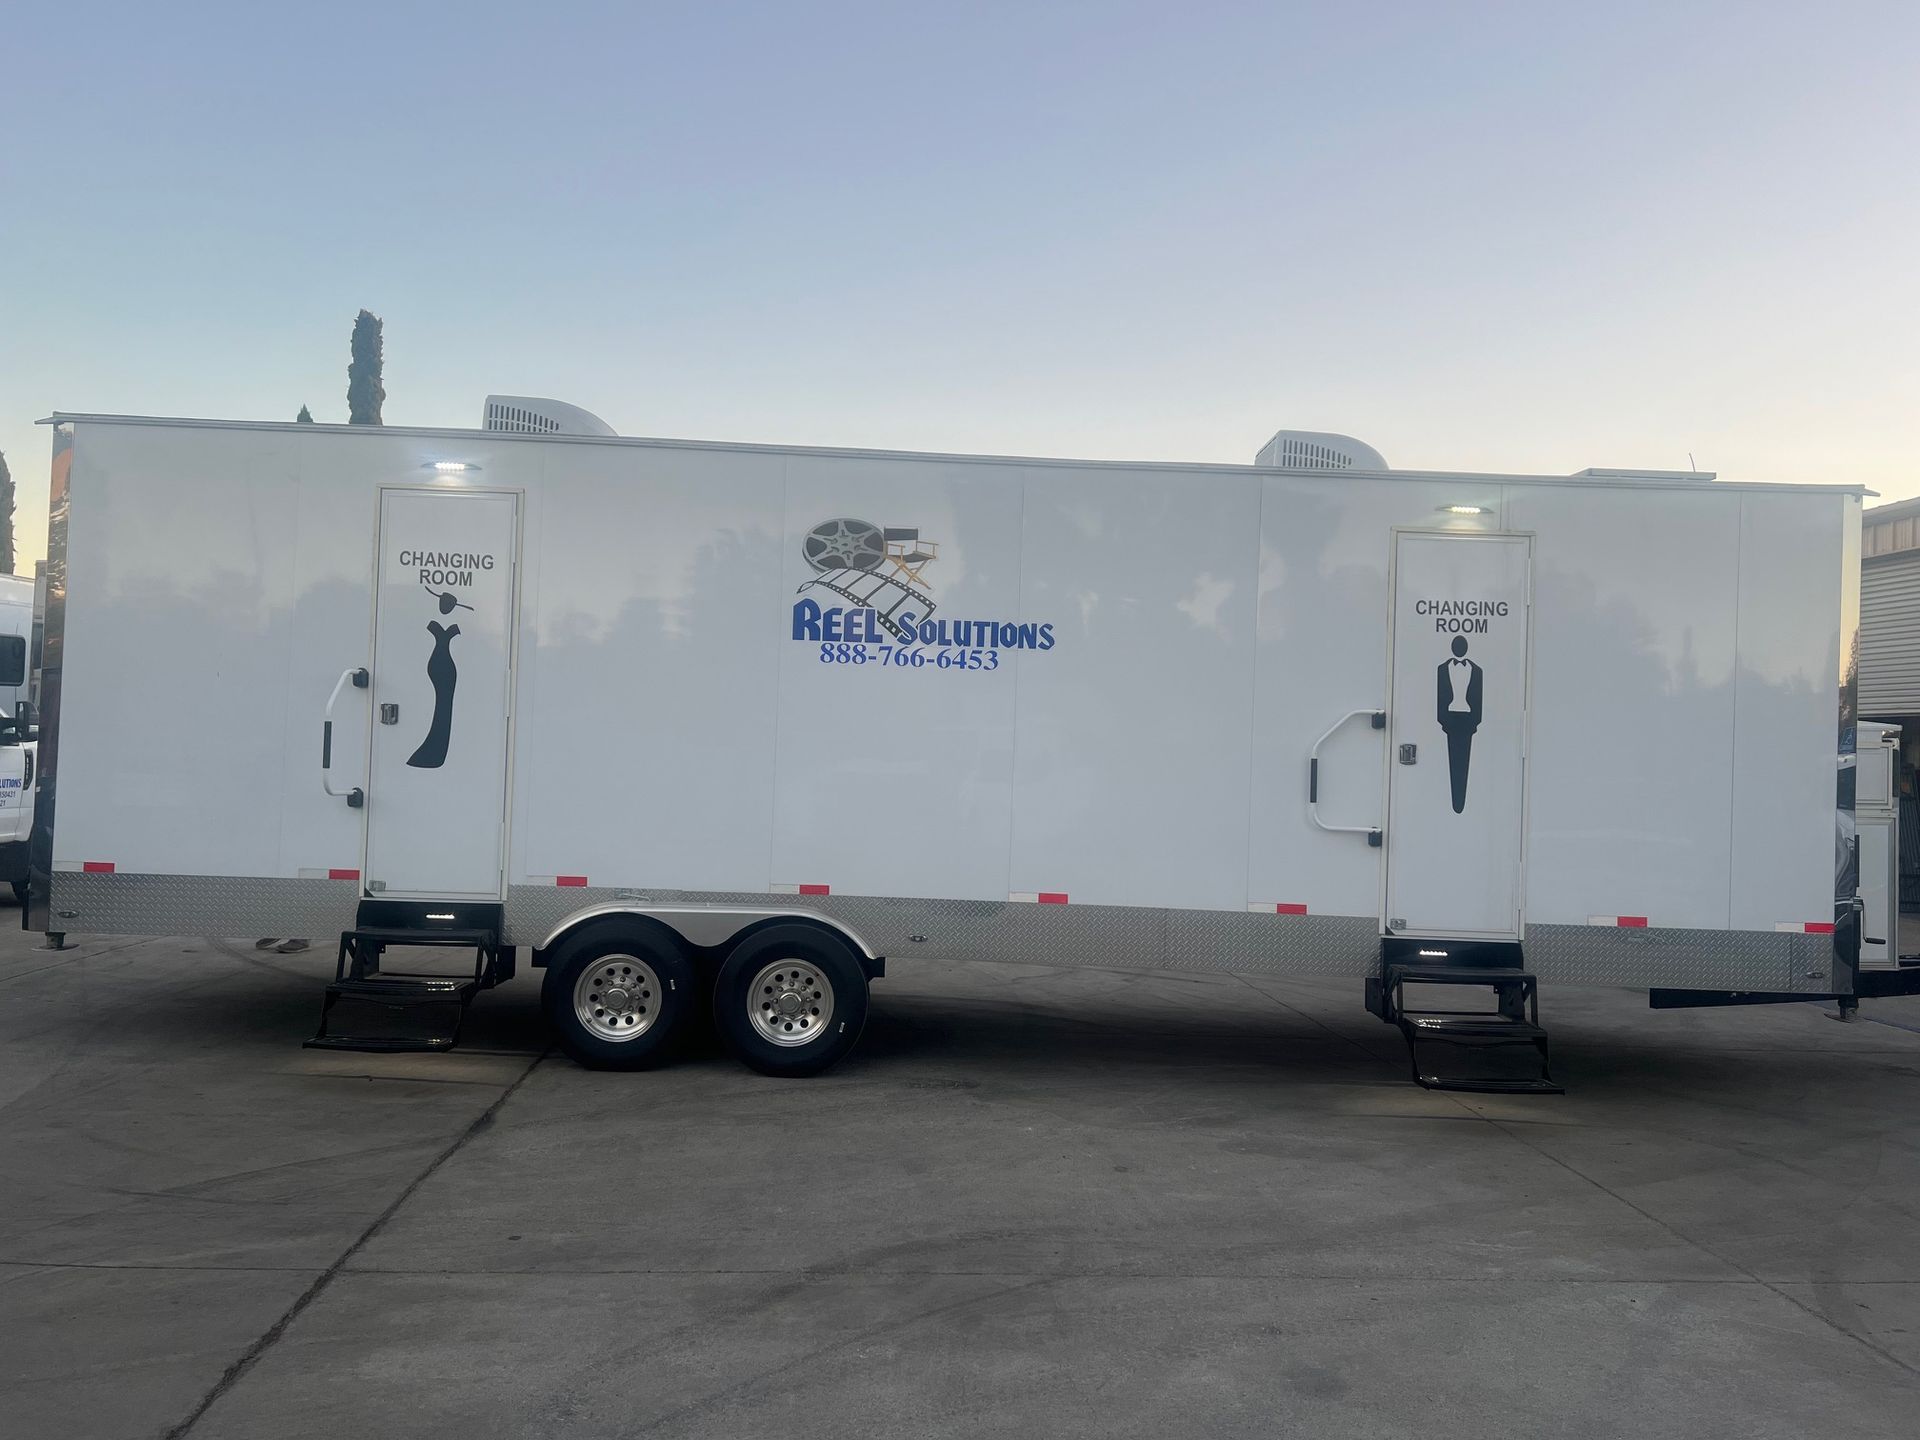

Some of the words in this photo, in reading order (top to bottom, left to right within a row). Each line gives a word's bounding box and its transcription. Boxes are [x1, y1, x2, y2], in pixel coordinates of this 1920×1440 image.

[399, 550, 494, 570] CHANGING
[419, 569, 473, 587] ROOM
[1415, 599, 1509, 617] CHANGING
[792, 598, 884, 643] REEL
[897, 611, 1056, 650] SOLUTIONS
[1435, 617, 1489, 634] ROOM
[819, 643, 999, 671] 888-766-6453
